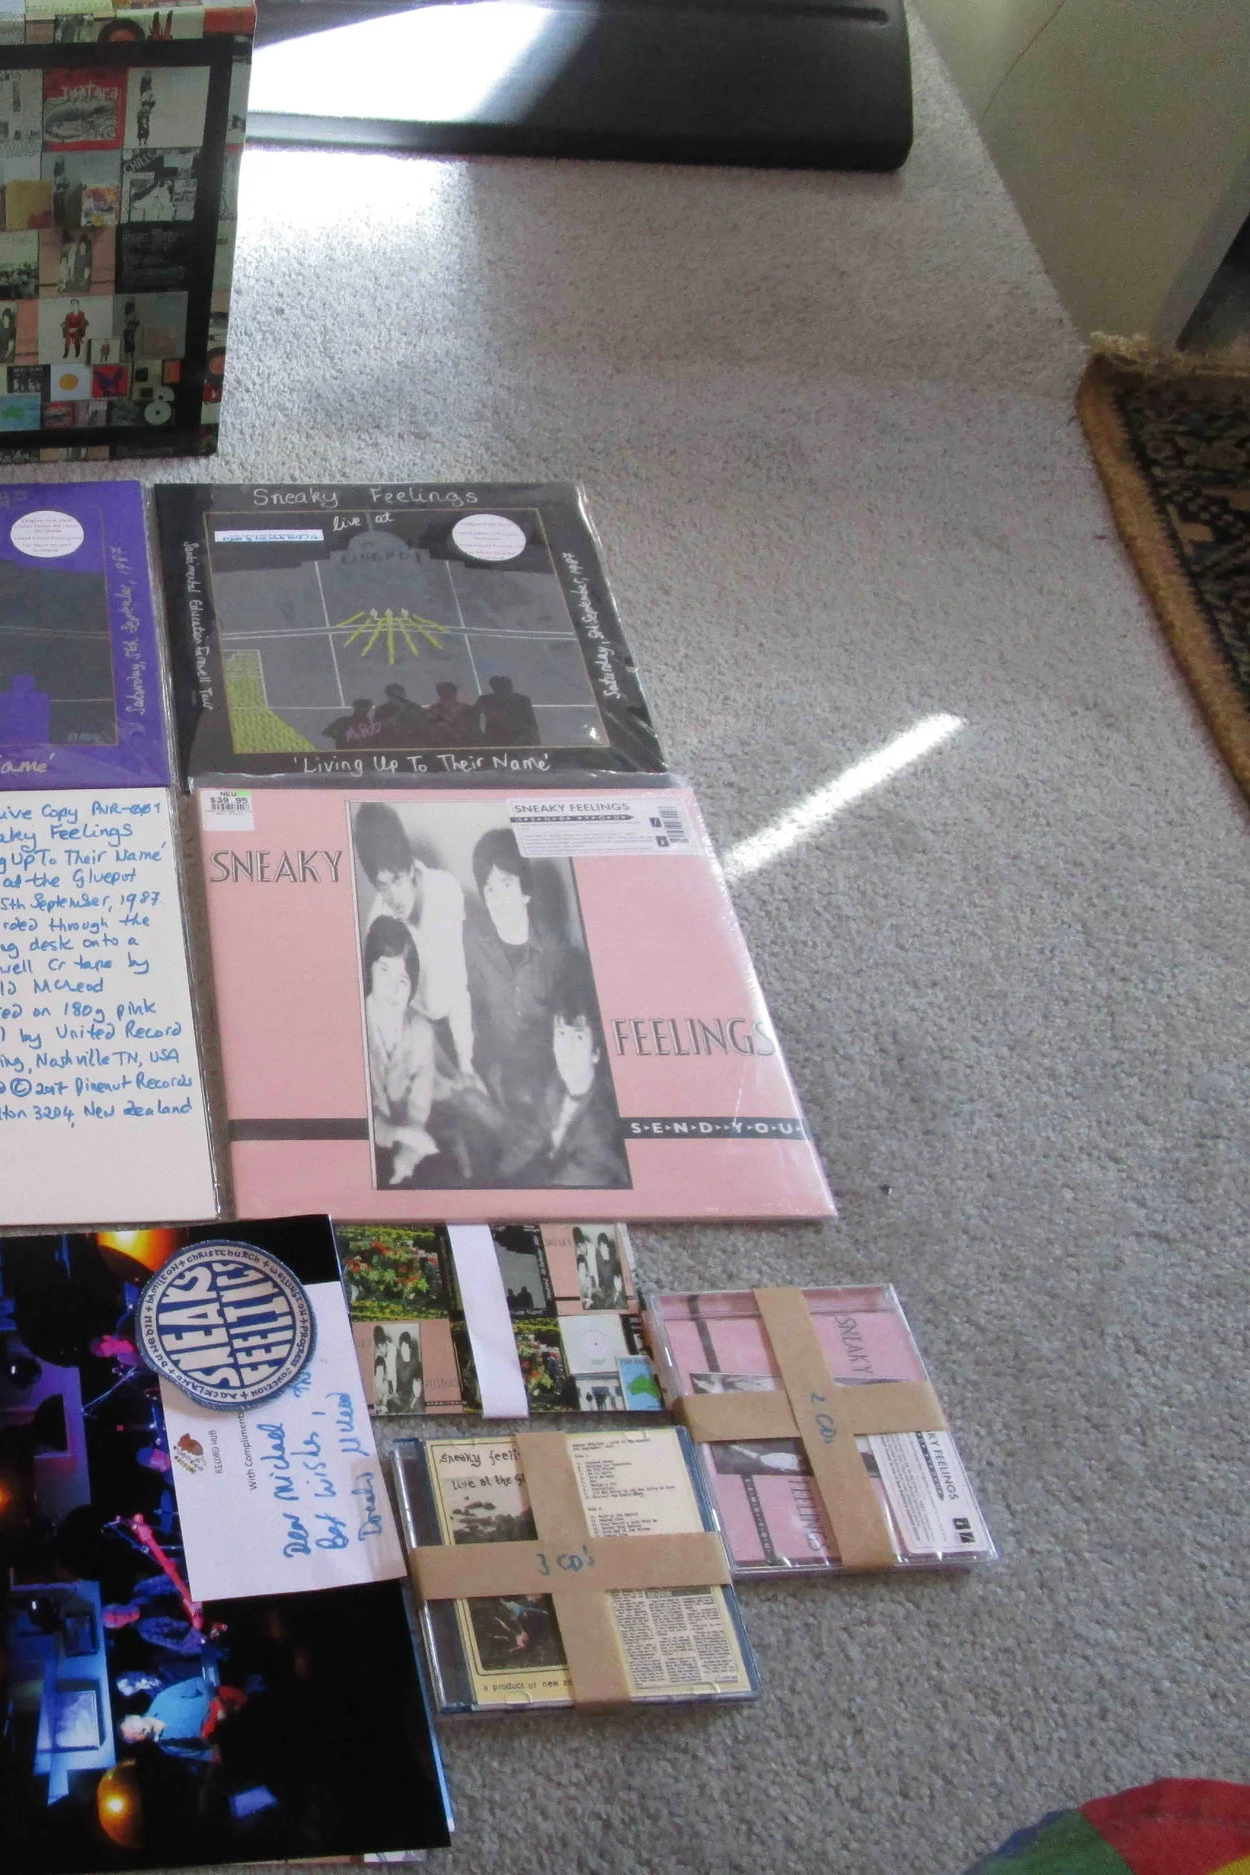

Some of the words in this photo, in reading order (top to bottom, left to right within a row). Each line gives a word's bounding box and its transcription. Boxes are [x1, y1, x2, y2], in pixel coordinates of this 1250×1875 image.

[253, 488, 339, 508] Sneaky
[370, 488, 478, 507] Feelings
[374, 512, 394, 523] at
[374, 756, 399, 774] Up
[407, 756, 428, 773] To
[437, 754, 483, 772] Their
[41, 803, 79, 824] Copy
[514, 804, 565, 813] SNEAKY
[569, 802, 630, 812] FEELINGS
[50, 823, 134, 847] Feelings
[11, 852, 36, 871] Up
[36, 848, 58, 866] To
[65, 849, 107, 866] Their
[210, 850, 342, 883] SNEAKY
[25, 872, 60, 888] the
[73, 867, 137, 889] Gluepot
[0, 897, 26, 911] 5th
[119, 913, 151, 927] the
[29, 935, 74, 951] desk
[127, 937, 139, 946] a
[48, 958, 66, 971] Cr
[74, 954, 112, 970] tape
[128, 952, 150, 975] by
[33, 1006, 51, 1017] on
[64, 1002, 105, 1023] 180g
[20, 1028, 42, 1050] by
[56, 1024, 115, 1040] United
[125, 1020, 182, 1039] Record
[611, 1018, 775, 1056] FEELINGS
[36, 1049, 110, 1069] Nashville
[149, 1048, 180, 1064] USA
[136, 1071, 193, 1089] Records
[84, 1101, 115, 1119] New
[123, 1097, 192, 1115] Zealand
[834, 1315, 873, 1375] SNEAKY
[810, 1393, 826, 1404] 2
[208, 1430, 218, 1445] HUB
[213, 1446, 223, 1474] RECORD
[256, 1422, 299, 1501] Michael
[245, 1472, 257, 1491] With
[495, 1475, 511, 1486] the
[932, 1450, 959, 1501] FEELINGS
[283, 1513, 311, 1558] Dear
[315, 1514, 348, 1550] Best
[537, 1553, 550, 1575] 3
[492, 1682, 525, 1692] product
